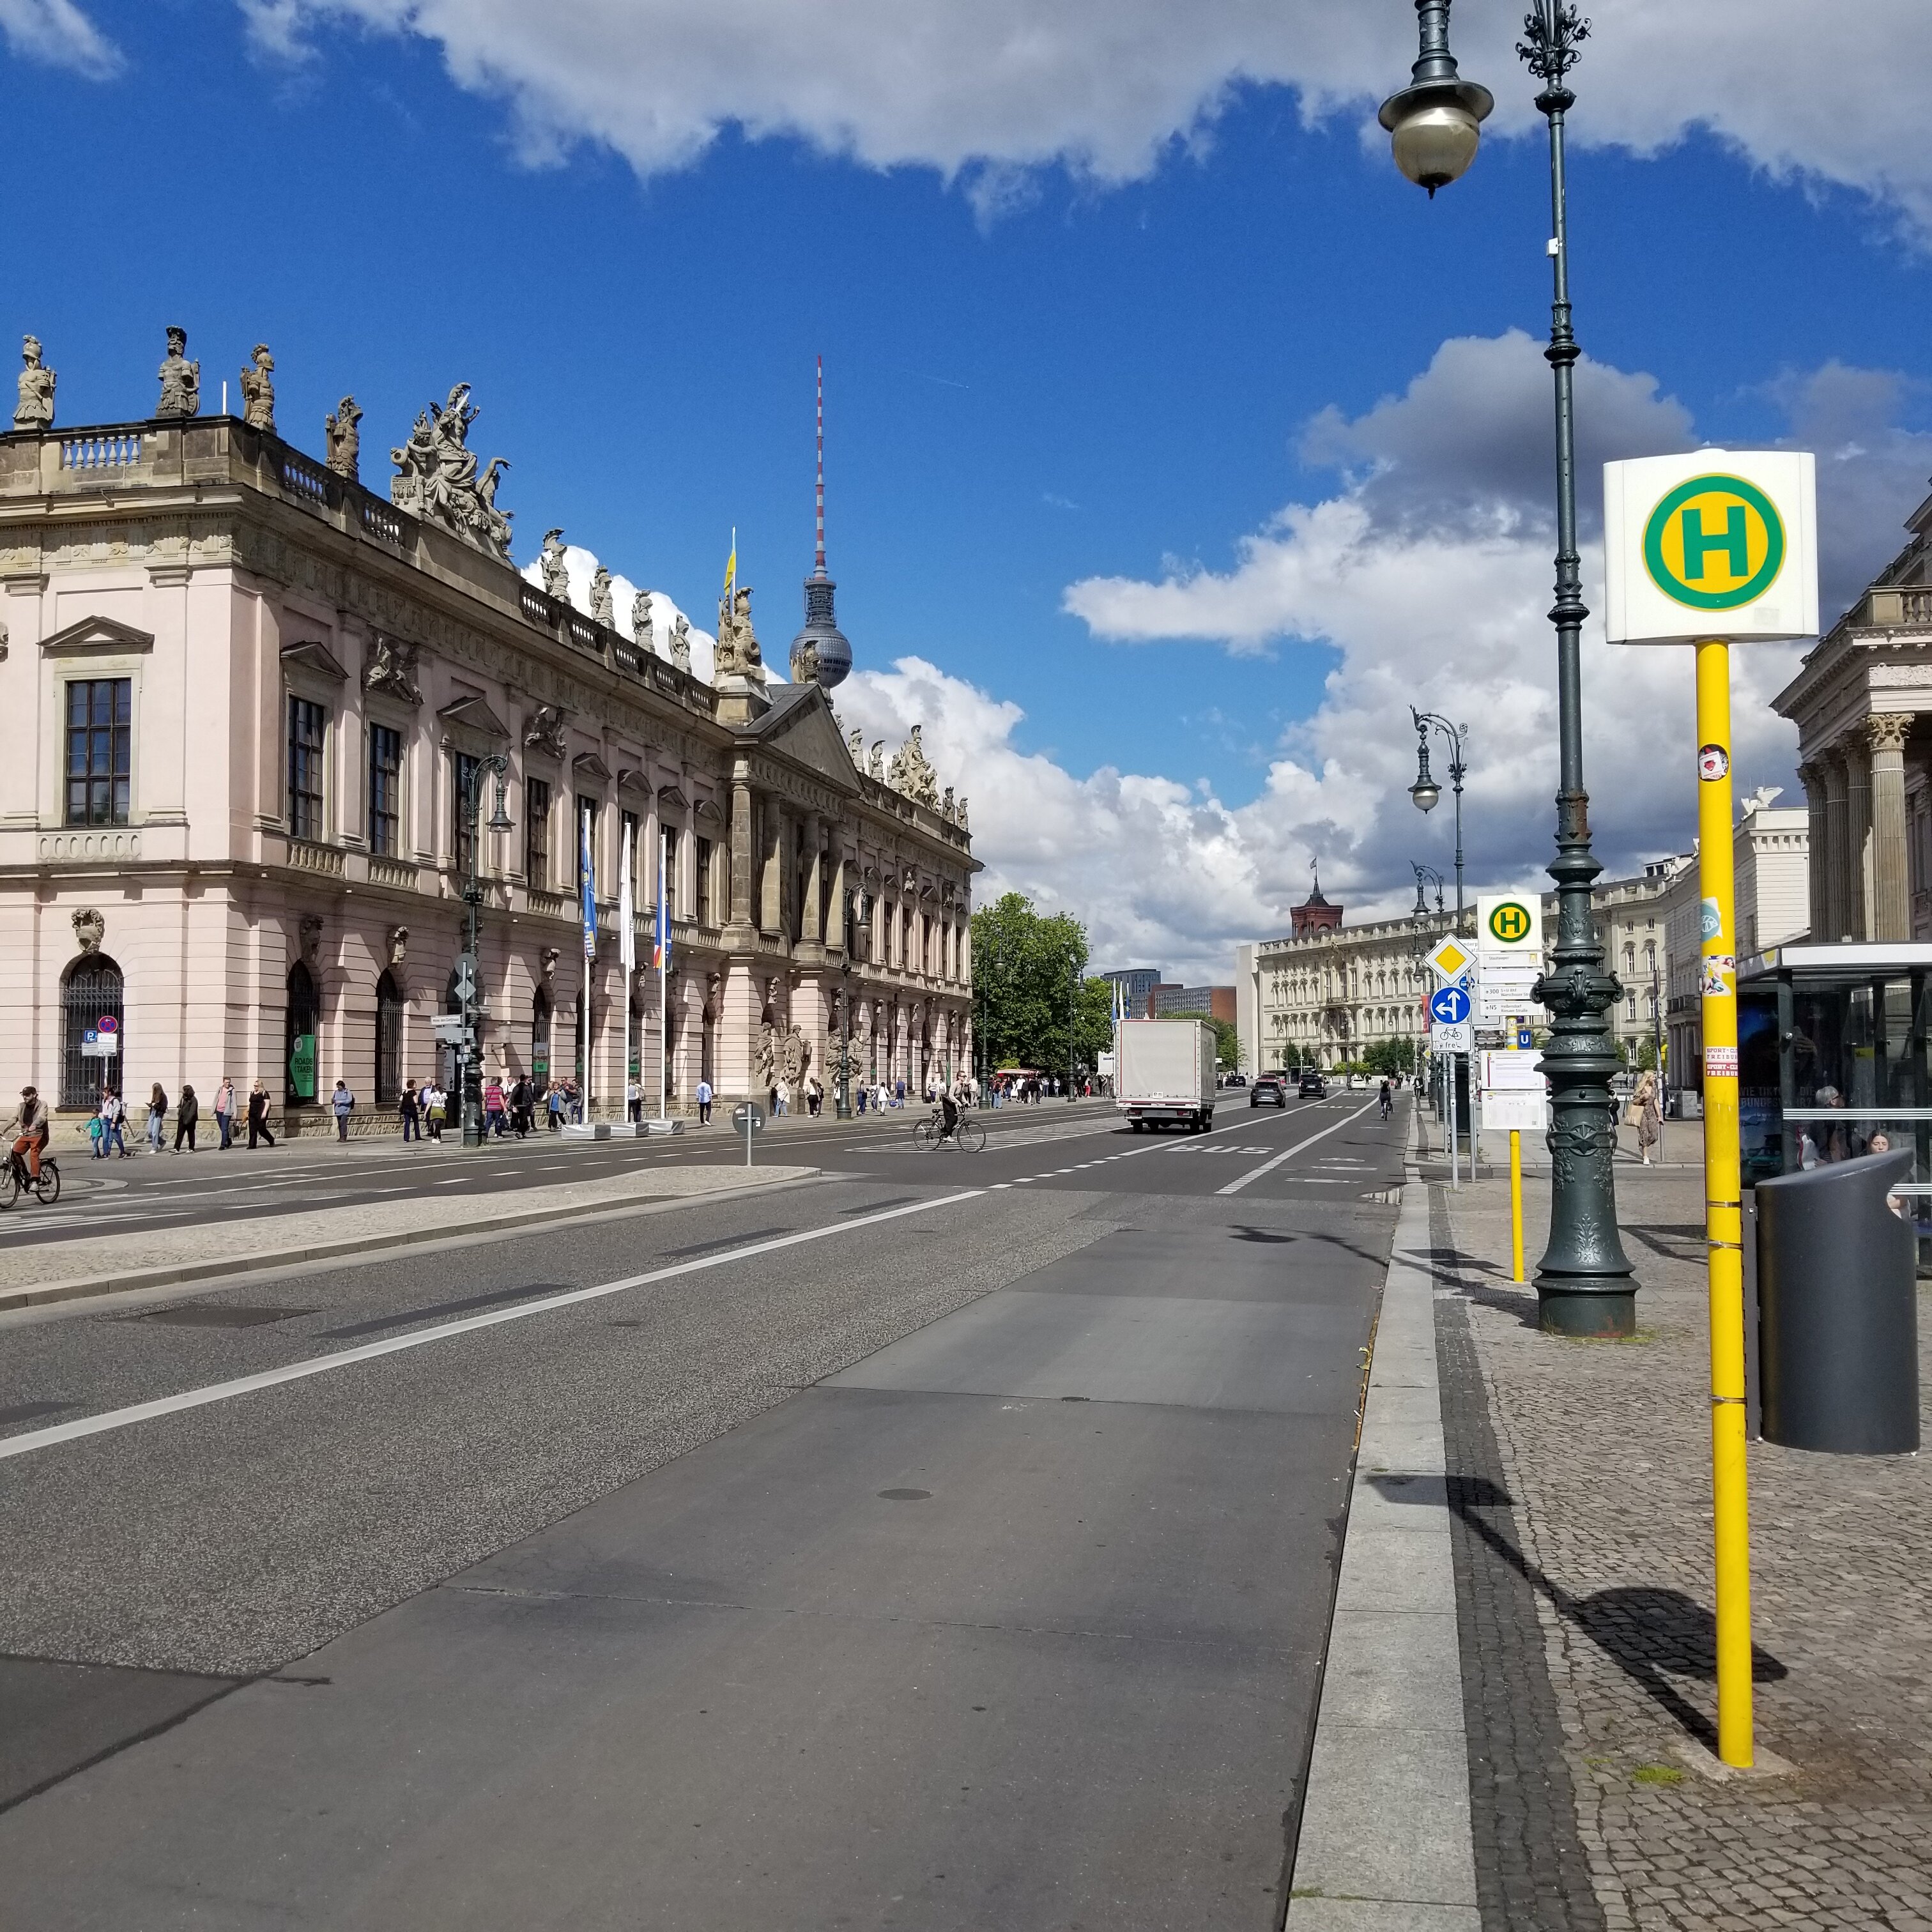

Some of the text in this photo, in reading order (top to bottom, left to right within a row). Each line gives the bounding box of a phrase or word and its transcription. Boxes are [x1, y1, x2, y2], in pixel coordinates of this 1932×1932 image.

[1682, 505, 1749, 580] H
[1501, 912, 1520, 933] H
[87, 1032, 94, 1040] P
[1521, 1035, 1529, 1044] U
[1163, 1145, 1275, 1154] BUS
